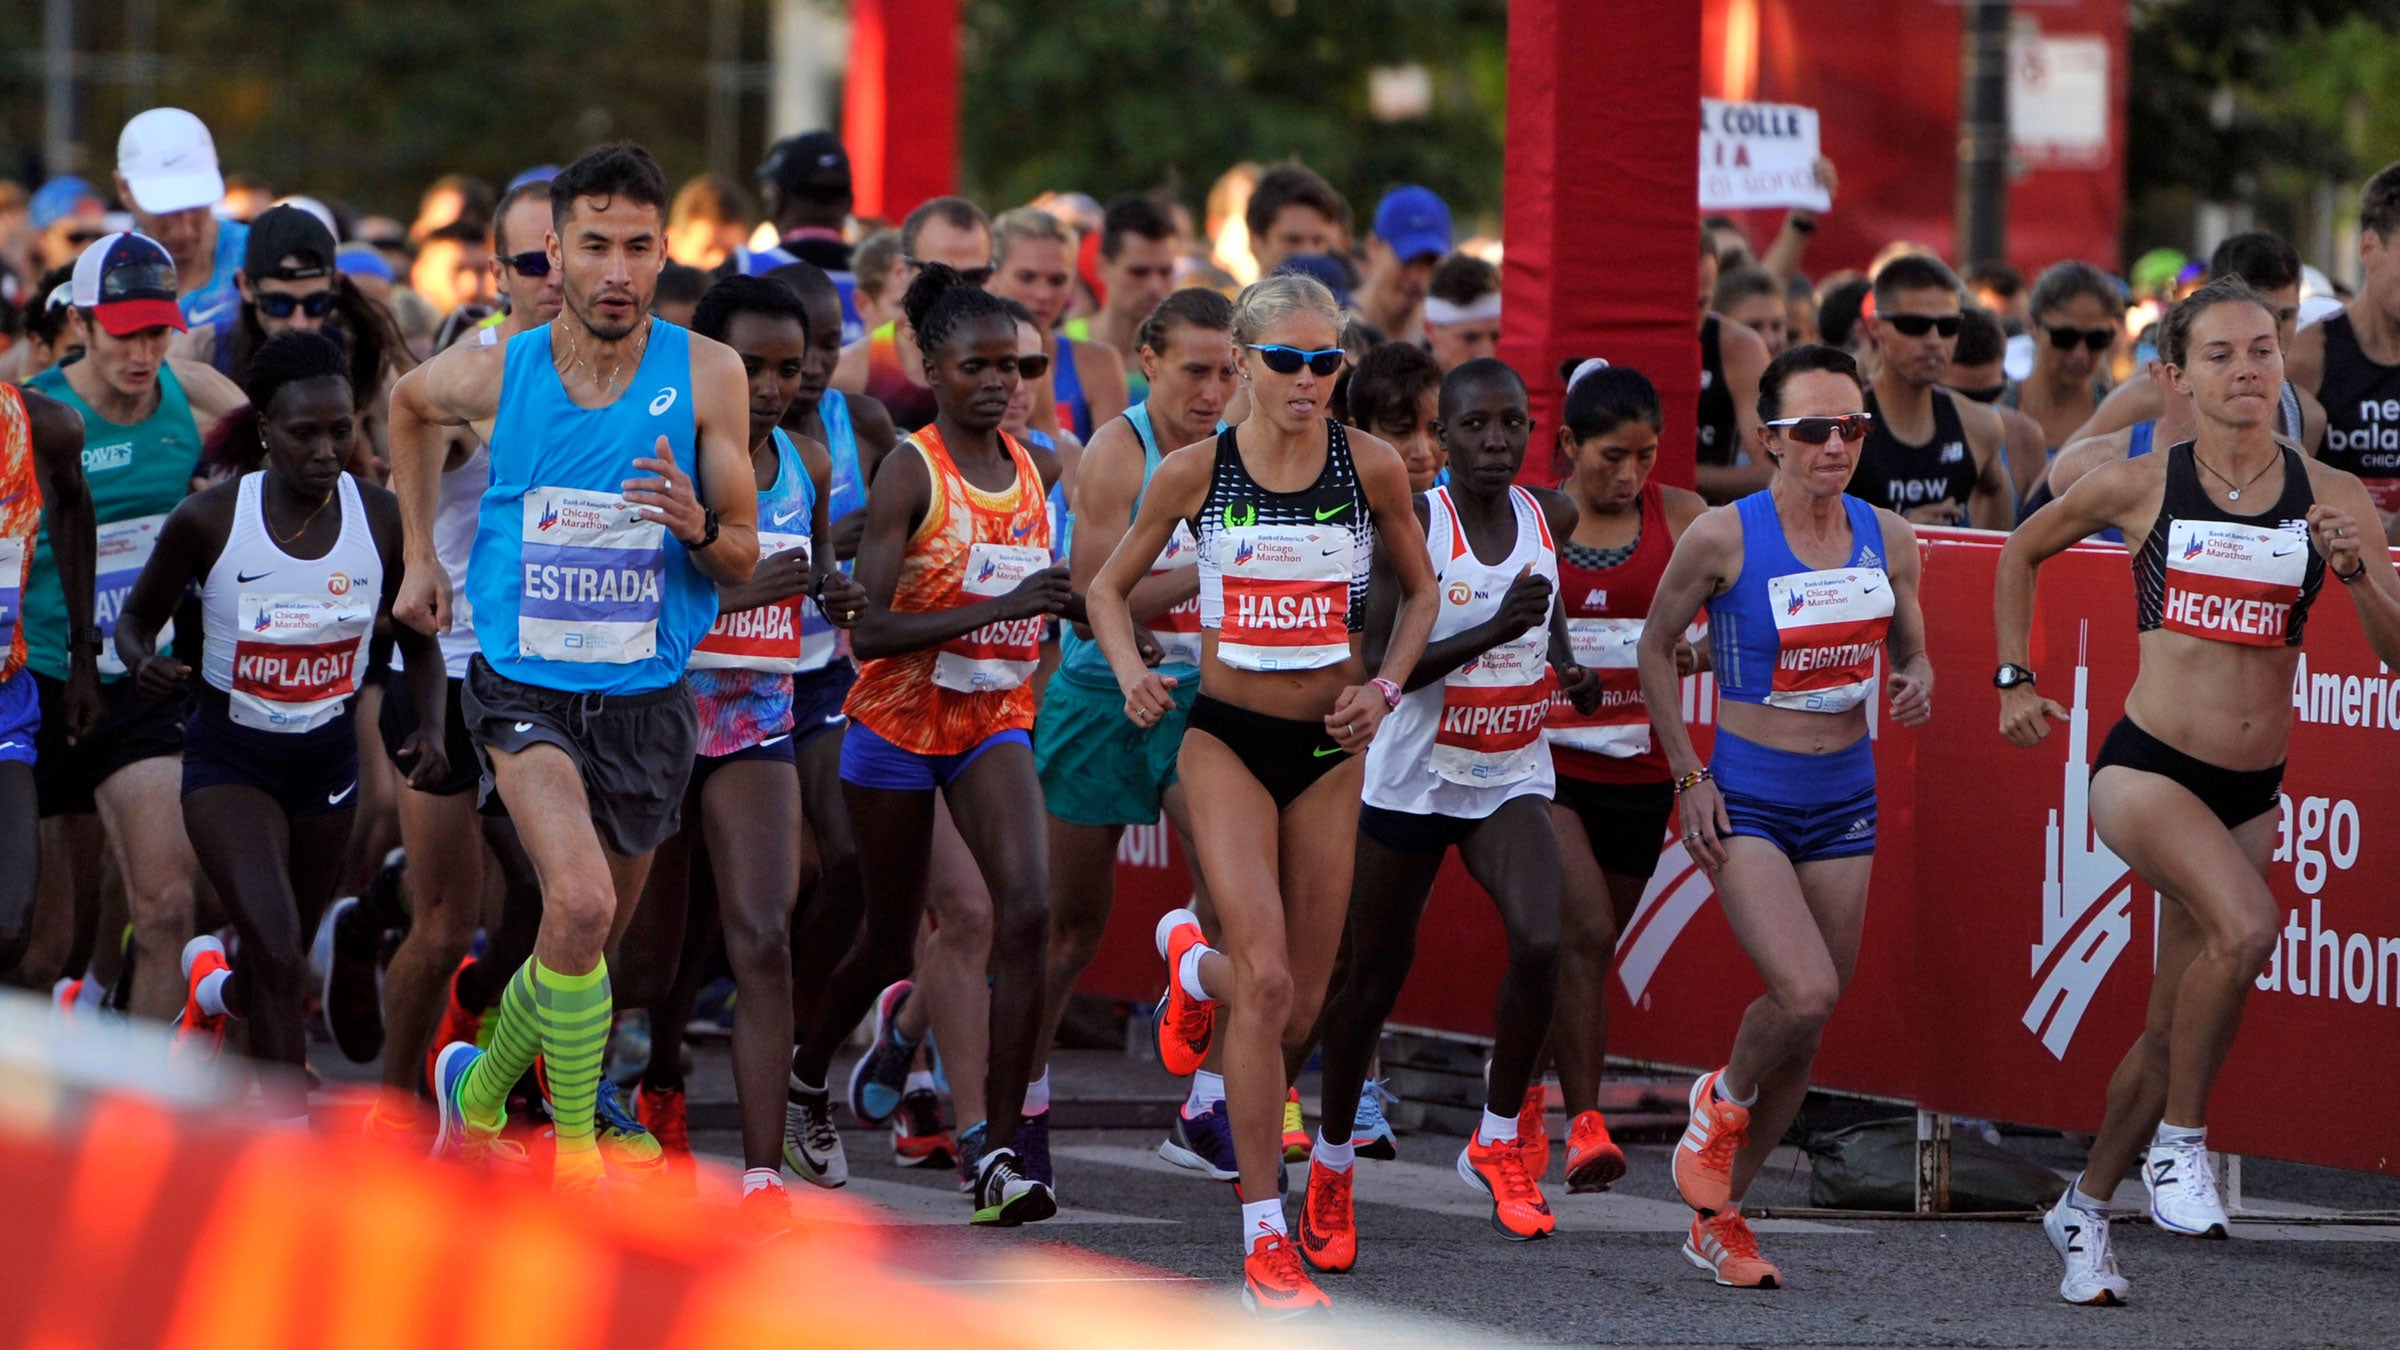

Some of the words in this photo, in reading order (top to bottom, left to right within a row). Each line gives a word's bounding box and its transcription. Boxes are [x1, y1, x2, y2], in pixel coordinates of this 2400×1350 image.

[2327, 422, 2400, 452] bala
[1889, 478, 1948, 501] new
[562, 508, 600, 520] Chicago
[561, 519, 609, 530] Marathon
[1257, 542, 1293, 555] Chicago
[2208, 539, 2244, 552] Chicago
[1256, 553, 1302, 562] Marathon
[2206, 549, 2252, 561] Marathon
[998, 562, 1024, 574] Chicago
[996, 571, 1024, 580] Marath
[354, 578, 368, 587] NN
[526, 563, 660, 603] ESTRADA
[1474, 591, 1488, 600] NN
[1806, 588, 1838, 600] Chicago
[1808, 597, 1848, 608] Marathon
[275, 611, 310, 624] Chicago
[1238, 594, 1331, 630] HASAY
[2166, 587, 2291, 636] HECKERT
[275, 620, 318, 629] Marathon
[709, 605, 794, 640] DIBABA
[961, 614, 1040, 646] OSGE
[1569, 636, 1596, 645] hicago
[1482, 652, 1516, 662] Chicago
[238, 651, 353, 687] KIPLAGAT
[1482, 660, 1522, 669] Marathon
[1602, 688, 1645, 706] ROJAS
[1445, 698, 1550, 736] KIPKETER
